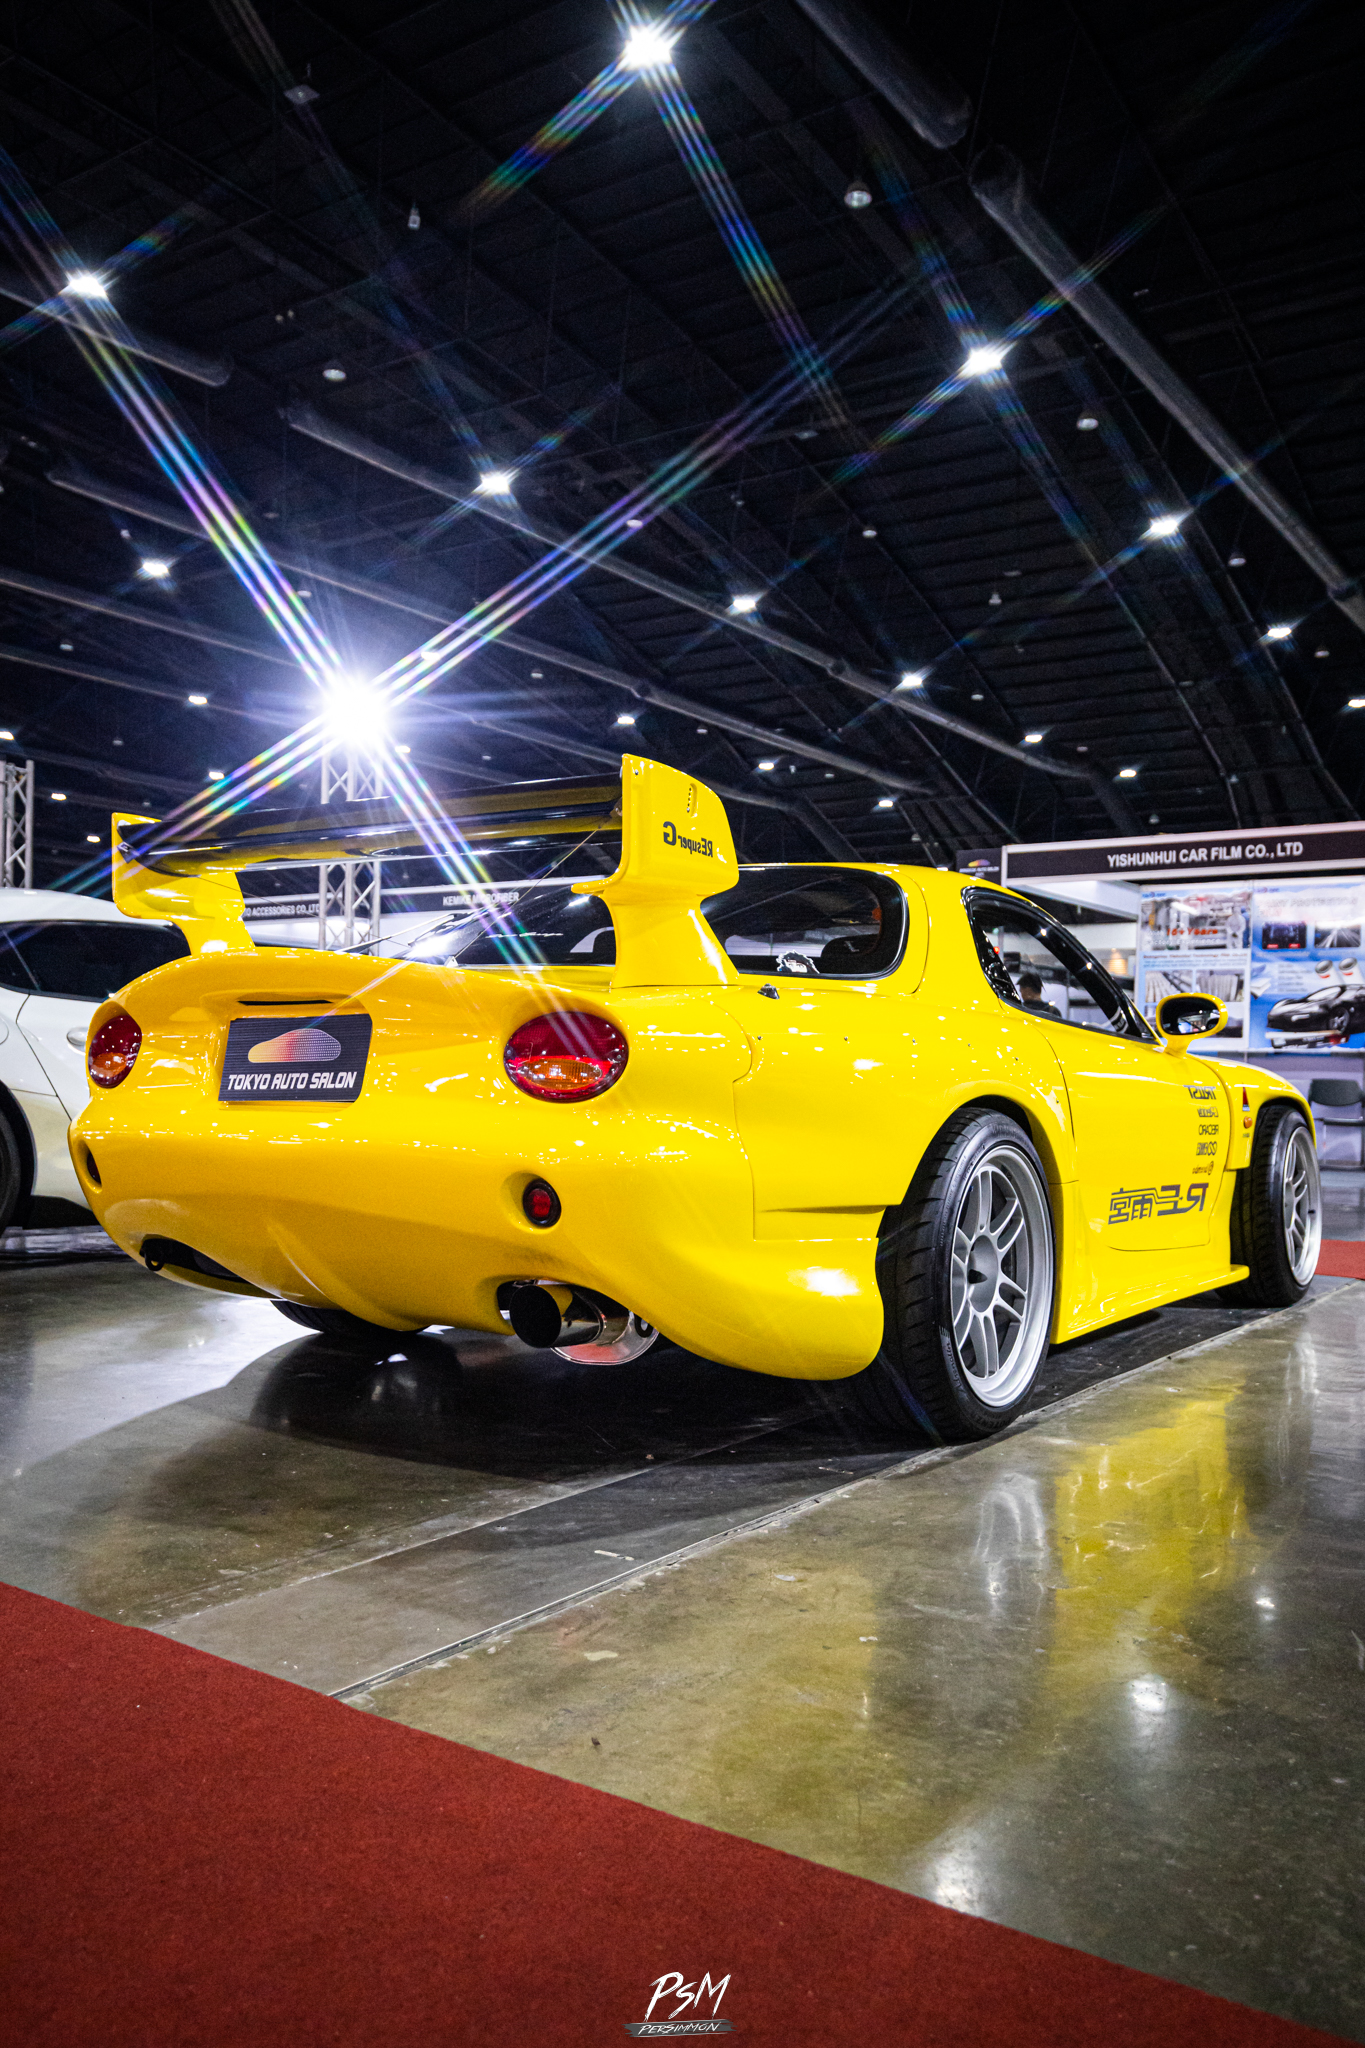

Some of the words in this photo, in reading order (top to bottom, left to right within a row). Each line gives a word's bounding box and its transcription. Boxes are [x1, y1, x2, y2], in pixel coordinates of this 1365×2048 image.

[1107, 848, 1176, 868] YISHUNHUI
[1179, 847, 1208, 864] CAR
[1211, 845, 1242, 861] FILM
[1276, 841, 1304, 857] LTD
[252, 904, 296, 917] ACCESSORIES
[228, 1073, 271, 1090] TOKYO
[271, 1072, 309, 1090] AUTO
[309, 1071, 358, 1089] SALON
